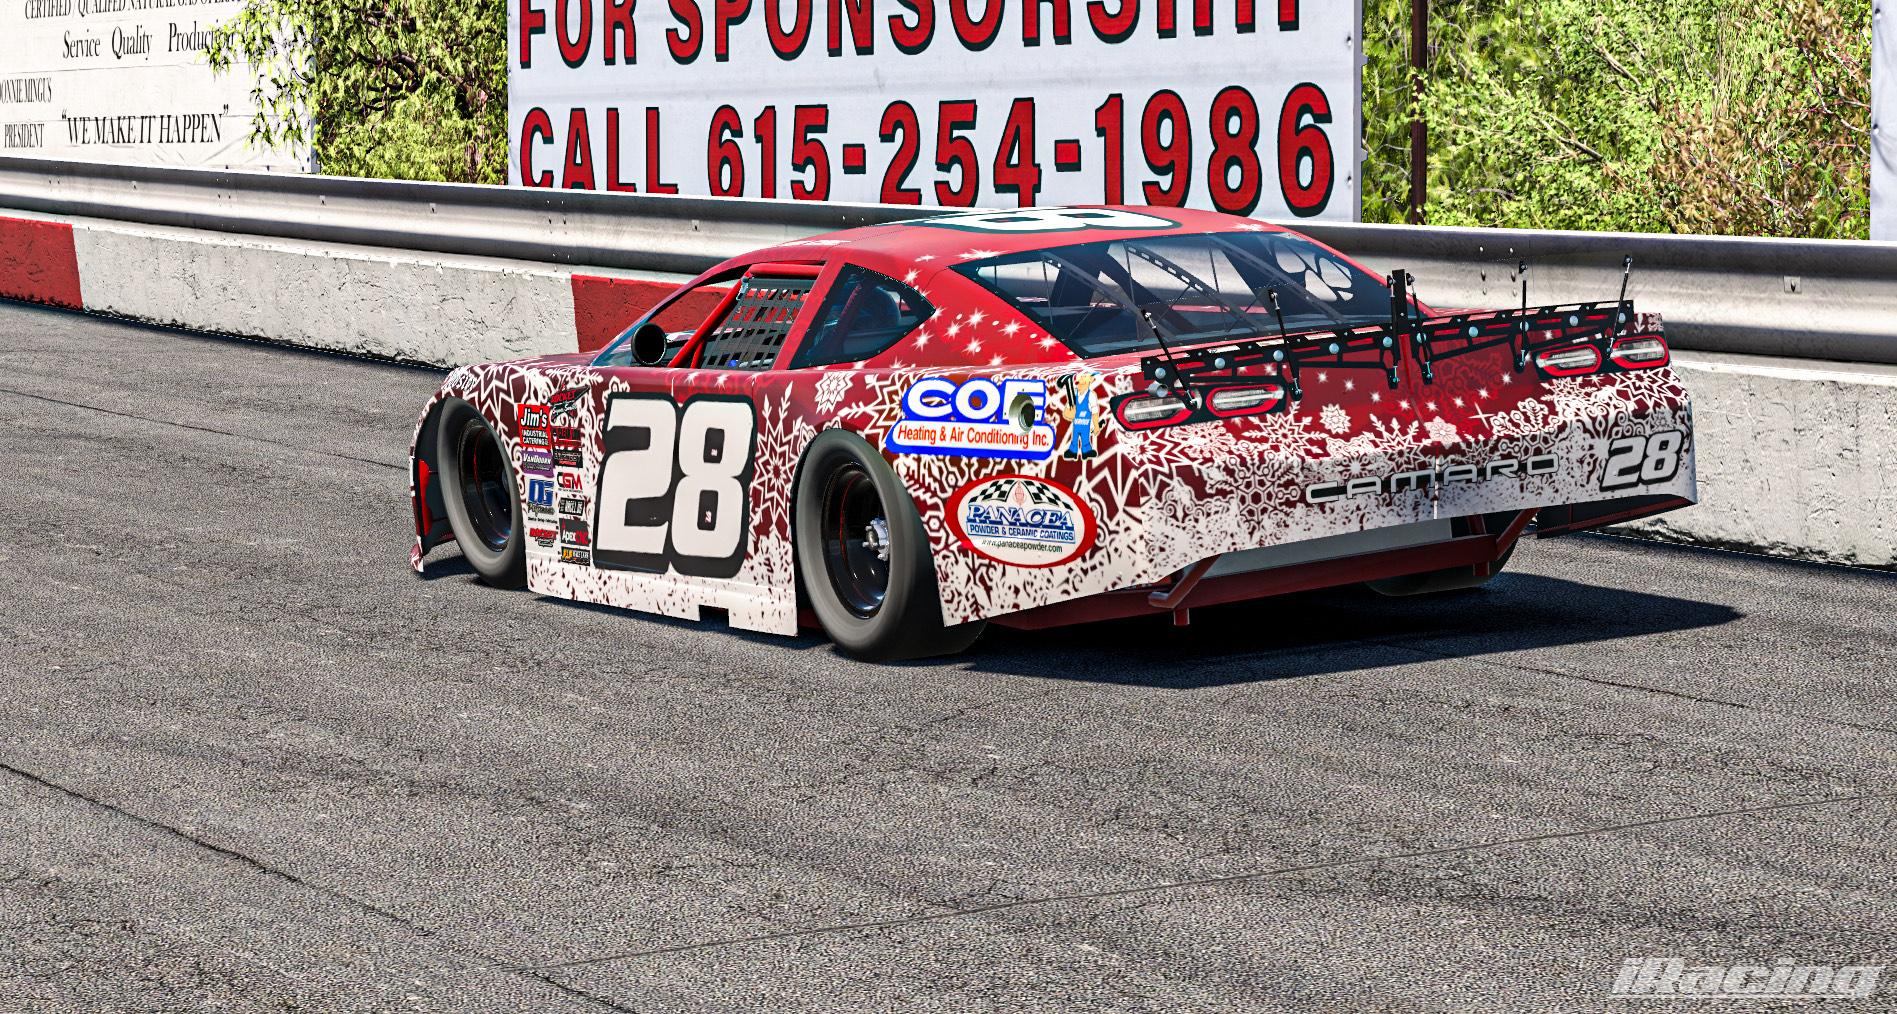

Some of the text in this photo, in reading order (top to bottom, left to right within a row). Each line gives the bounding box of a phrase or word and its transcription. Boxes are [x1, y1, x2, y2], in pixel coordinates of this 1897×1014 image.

[63, 29, 101, 59] Service
[112, 25, 152, 60] Quality
[519, 0, 637, 69] FOR
[4, 124, 44, 148] PRESIDENT
[94, 116, 137, 144] MAKE
[140, 115, 157, 143] IT
[519, 82, 1334, 217] CALL 615-254-1986
[520, 408, 550, 430] Jim's
[898, 426, 1050, 450] Heating & Air Conditioning Inc.
[1600, 431, 1682, 489] 28
[594, 394, 757, 576] 28
[1305, 454, 1559, 505] CAMARO
[967, 504, 1074, 529] PANACEA
[970, 524, 1074, 541] POWDER & CERAMIC COATINGS
